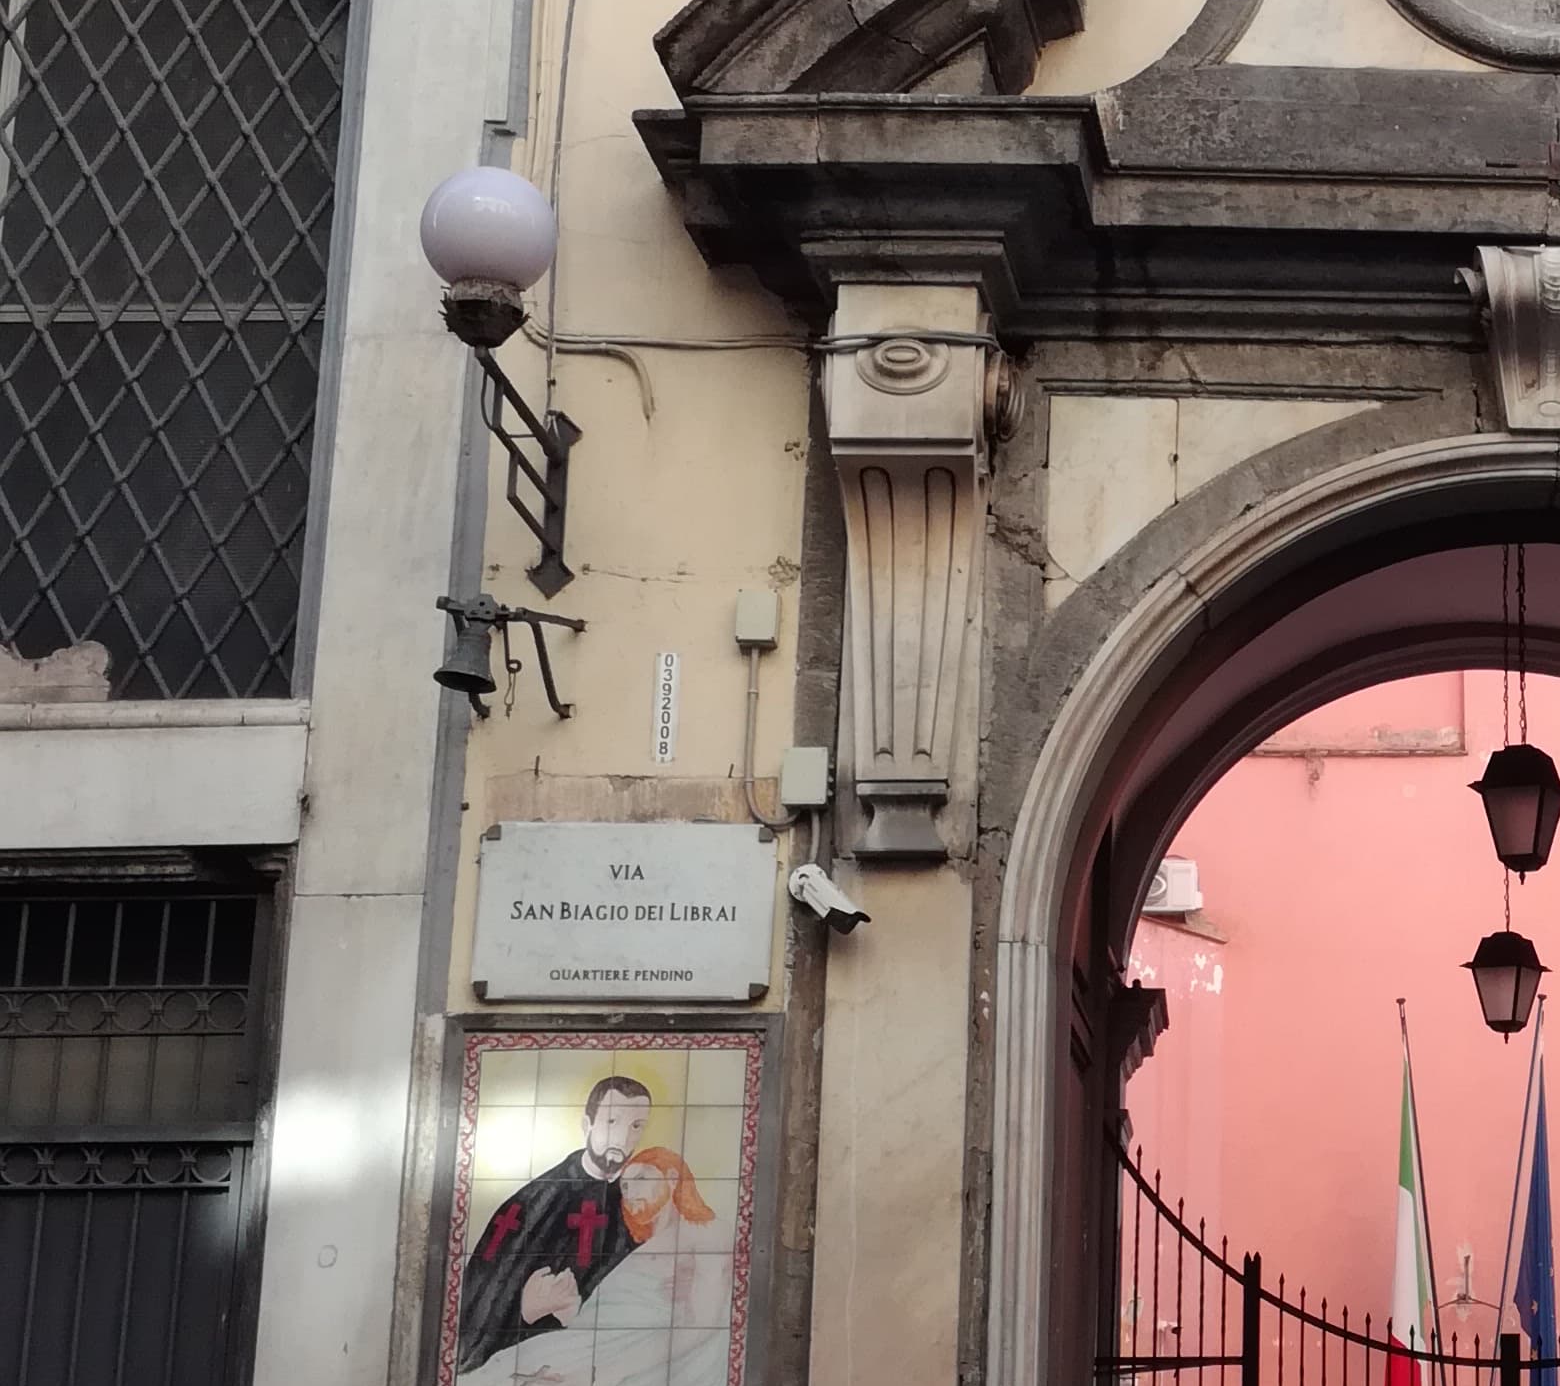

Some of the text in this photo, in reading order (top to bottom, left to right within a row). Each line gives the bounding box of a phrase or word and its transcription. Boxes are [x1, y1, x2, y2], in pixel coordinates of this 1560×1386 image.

[659, 654, 674, 755] 0392008
[609, 863, 645, 881] VIA
[510, 900, 737, 923] SAN BIAGIO DEI LIBRAI
[549, 969, 693, 982] QUARTIERE PENDINO
